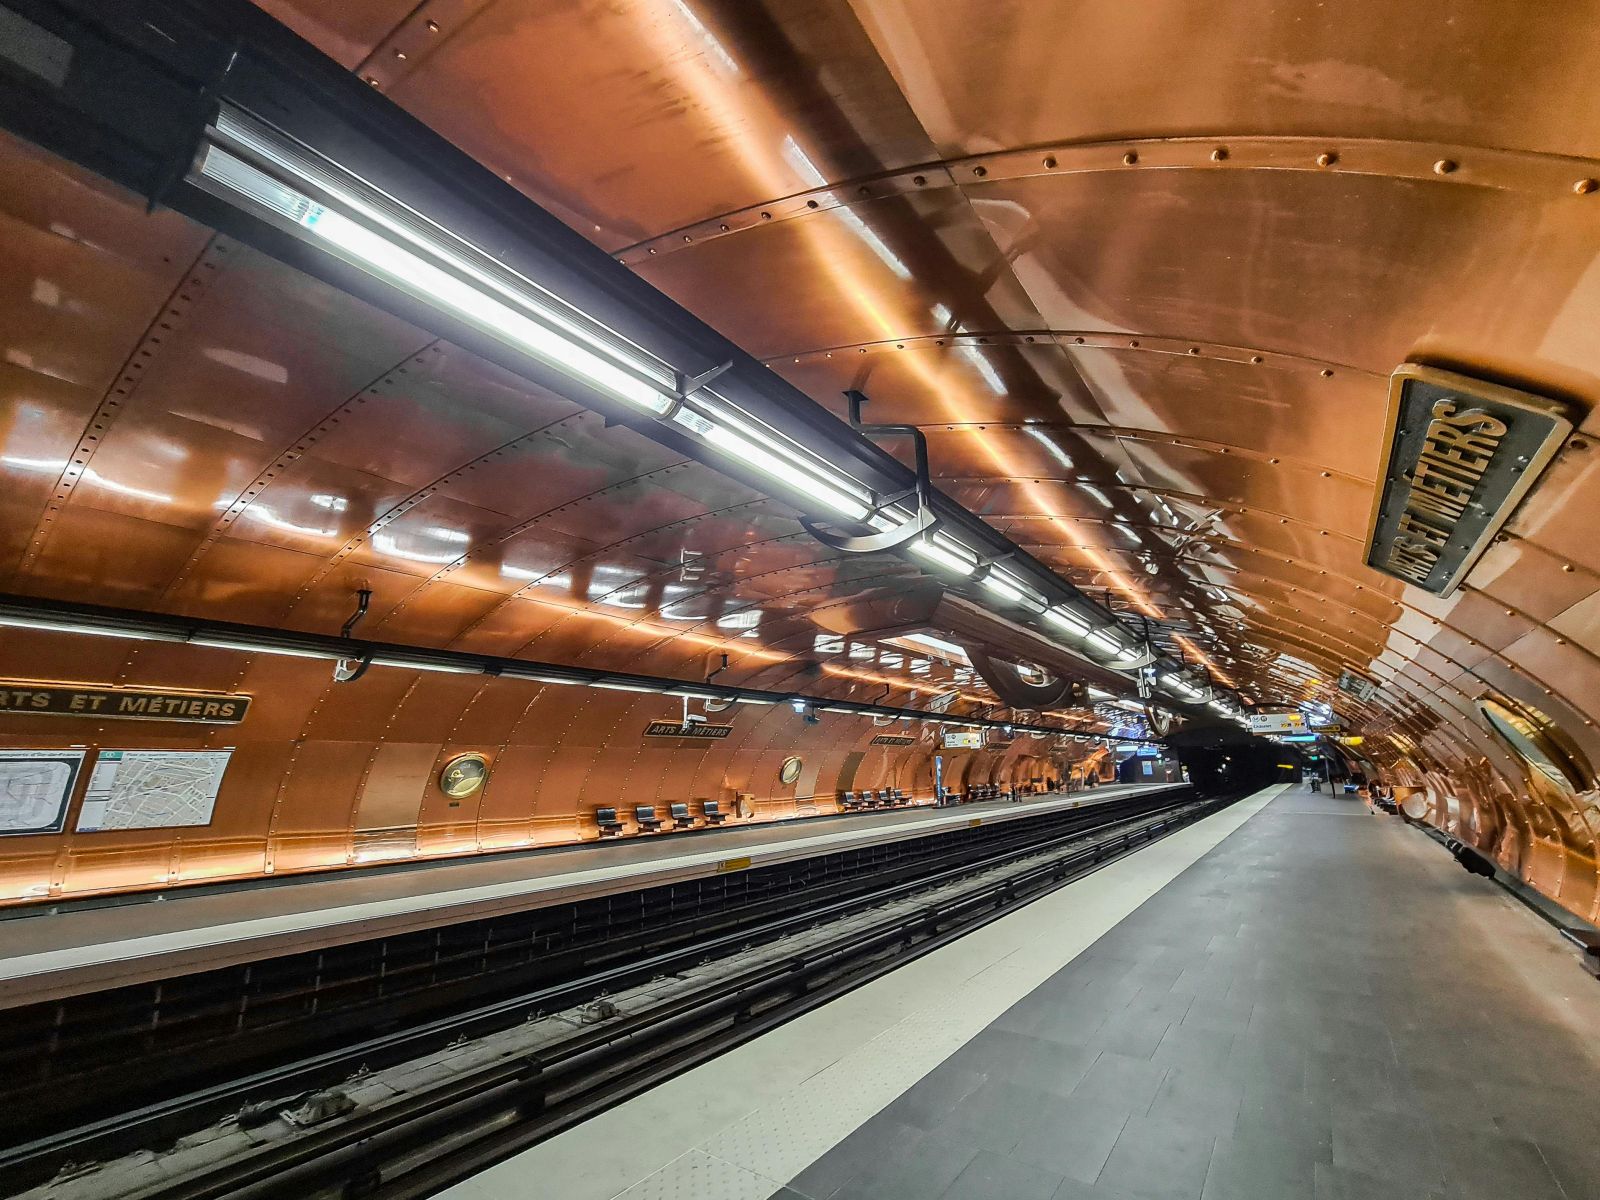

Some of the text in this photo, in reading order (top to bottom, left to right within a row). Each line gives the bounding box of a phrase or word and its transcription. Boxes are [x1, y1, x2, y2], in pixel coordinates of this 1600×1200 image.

[1387, 398, 1508, 584] ARTS ET MÉTIERS
[69, 694, 107, 710] ET
[119, 694, 237, 717] MÉTIERS
[651, 725, 676, 734] ARTS
[691, 727, 728, 736] MÉTIERS
